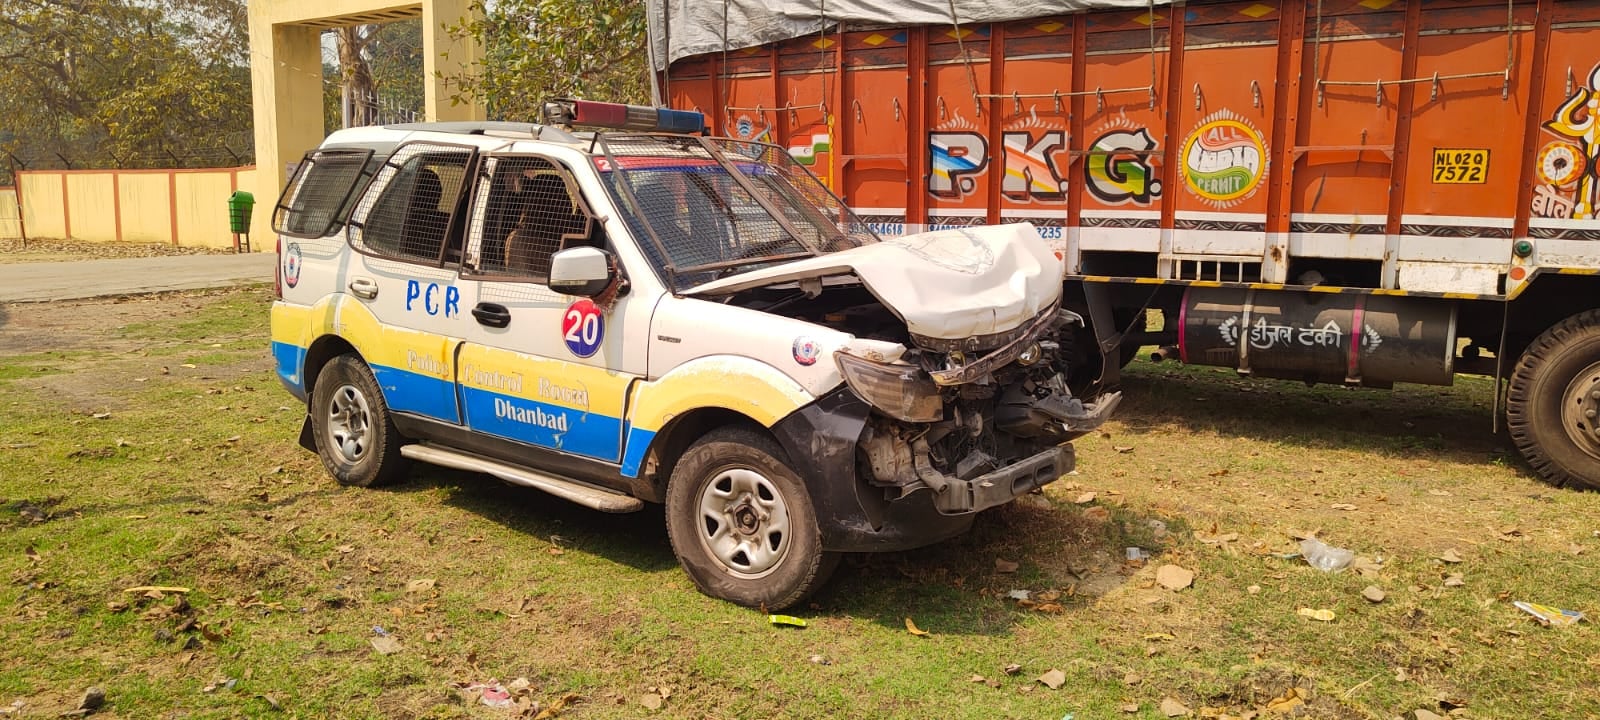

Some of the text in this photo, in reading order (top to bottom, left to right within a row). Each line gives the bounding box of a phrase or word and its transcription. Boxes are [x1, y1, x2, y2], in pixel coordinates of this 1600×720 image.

[1207, 127, 1242, 141] ALL
[1436, 153, 1452, 165] NL
[1455, 153, 1471, 165] 02
[1197, 176, 1242, 194] PERMIT
[1435, 166, 1481, 181] 7572
[406, 280, 460, 318] PCR
[565, 310, 598, 346] 20
[464, 364, 523, 393] Control
[538, 376, 590, 407] Room
[494, 398, 568, 432] Dhanbad
